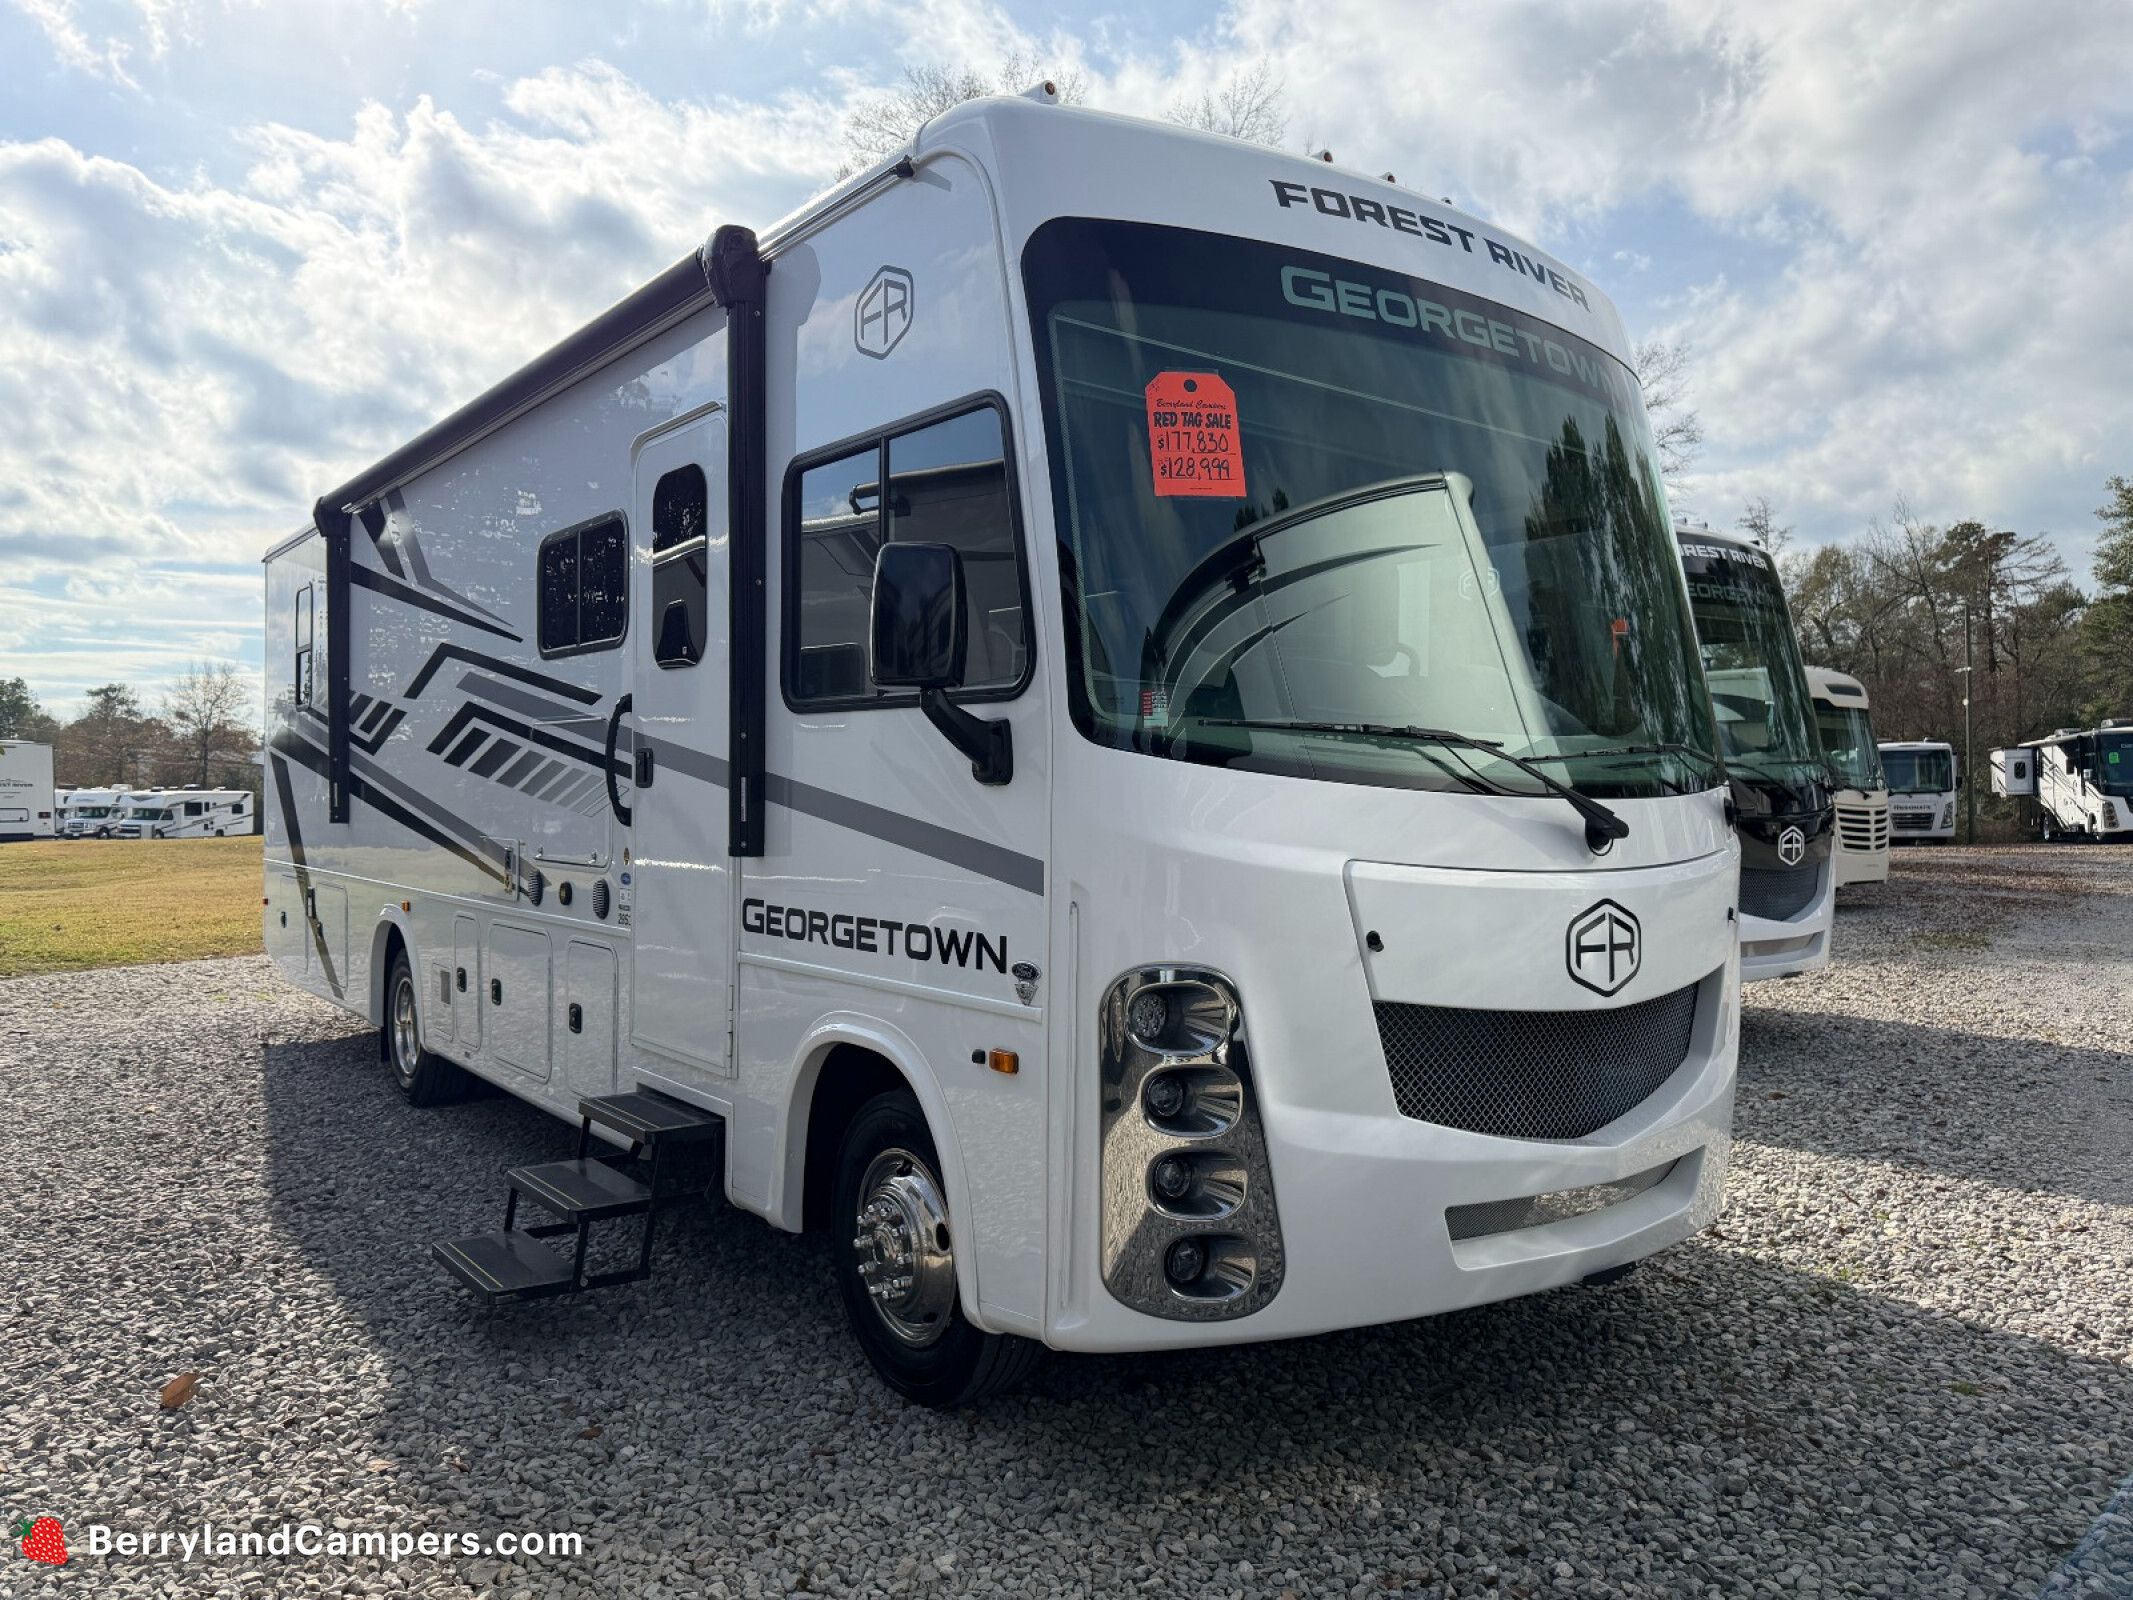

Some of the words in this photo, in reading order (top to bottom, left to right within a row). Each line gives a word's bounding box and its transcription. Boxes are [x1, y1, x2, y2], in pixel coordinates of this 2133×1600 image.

[1269, 179, 1475, 253] FOREST
[1483, 237, 1592, 313] RIVER
[1280, 265, 1619, 402] GEORGETOWN
[1153, 411, 1178, 428] RED
[1181, 411, 1203, 428] TAG
[1205, 412, 1232, 430] SALE
[1157, 430, 1229, 454] $177,830
[1160, 457, 1231, 481] $128,999
[1680, 543, 1727, 560] REST
[1728, 548, 1769, 572] RIVER
[742, 897, 1008, 974] GEORGETOWN
